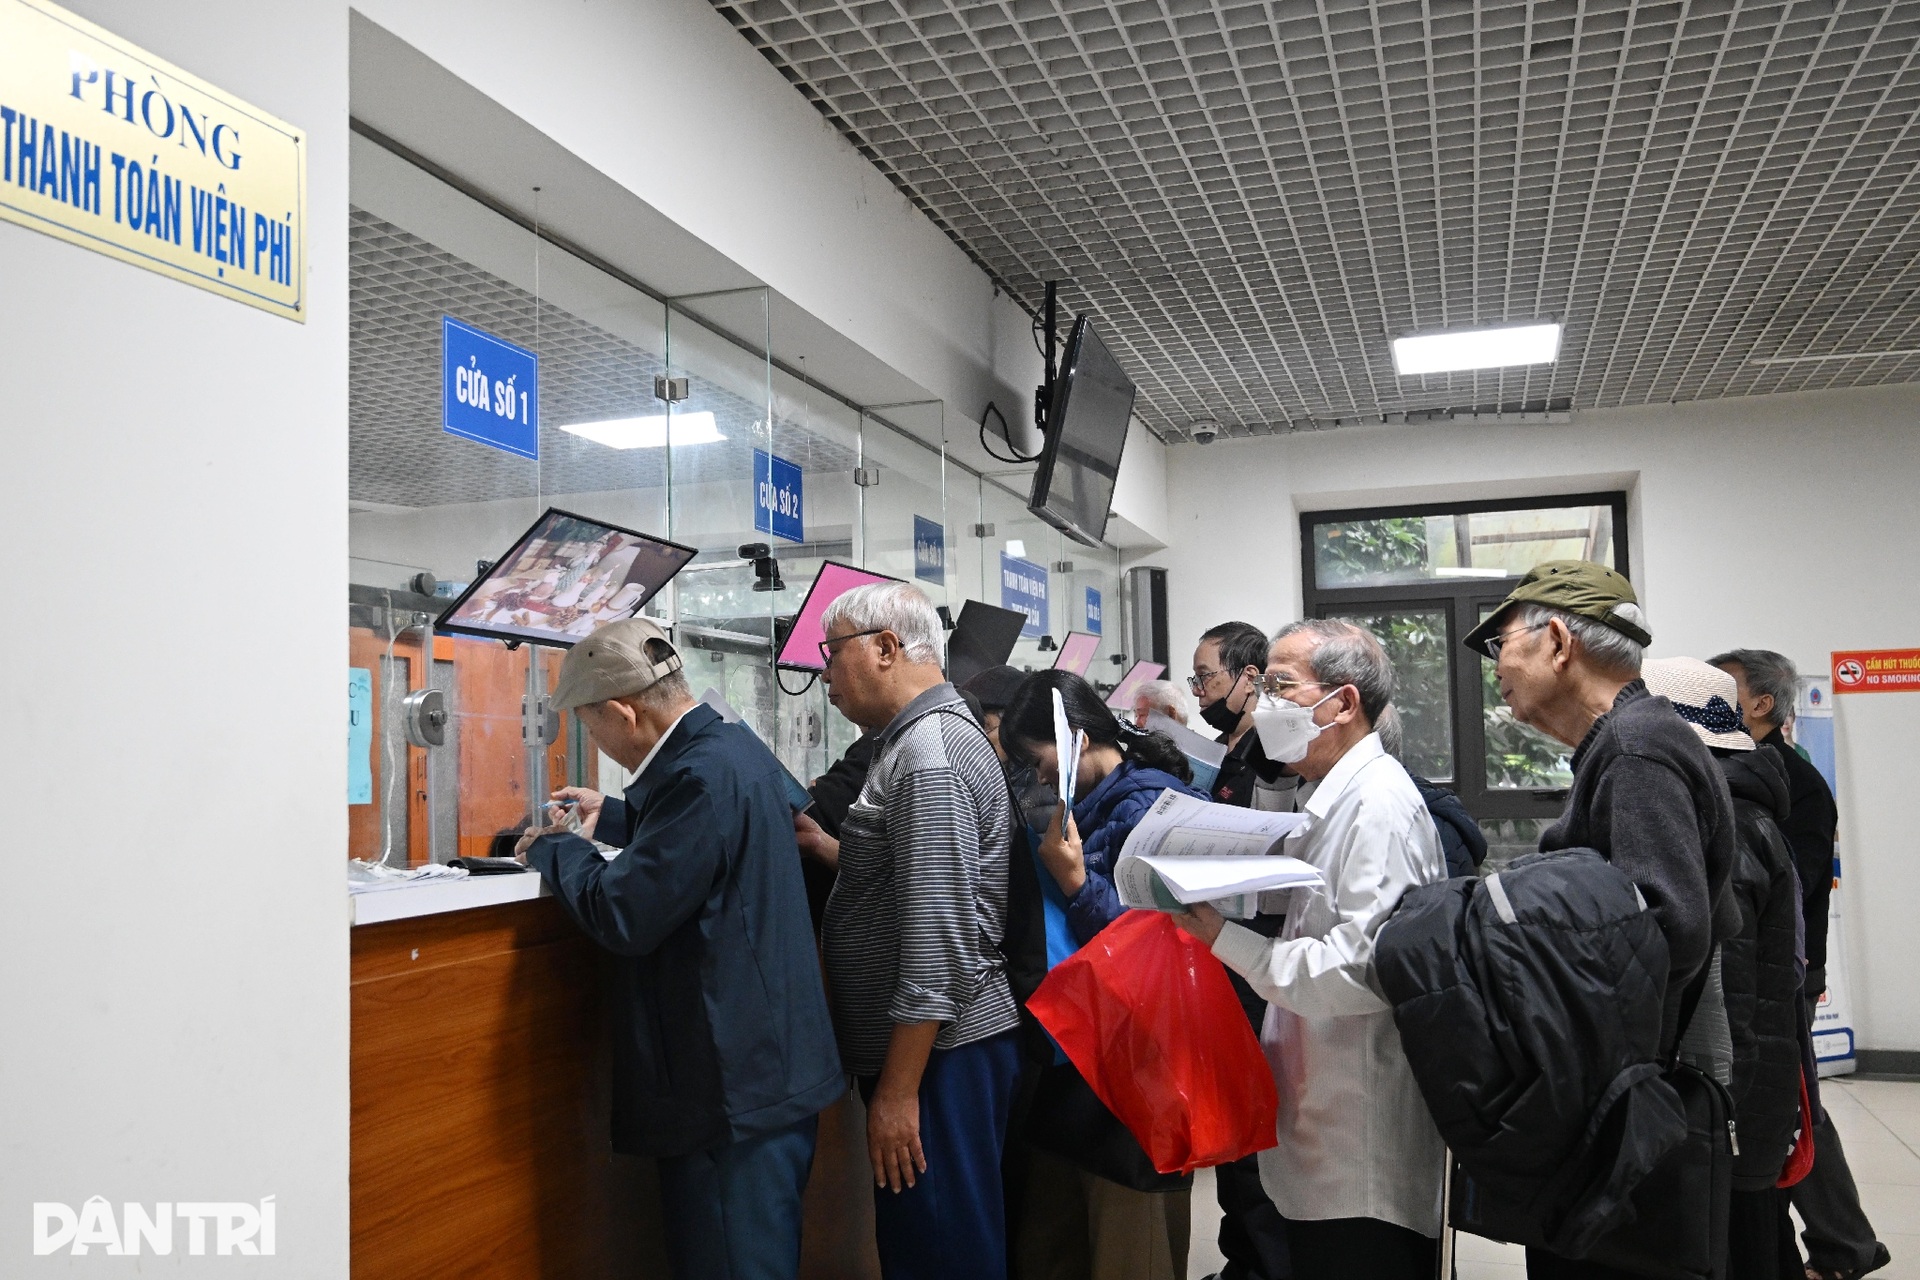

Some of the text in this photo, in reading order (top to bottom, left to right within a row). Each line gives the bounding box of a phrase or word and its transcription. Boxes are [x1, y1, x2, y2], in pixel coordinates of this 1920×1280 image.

[69, 54, 243, 170] PHÒNG
[1, 104, 291, 287] THANH TOÁN VIỆN PHÍ
[456, 355, 528, 426] CỬA SỐ 1
[759, 472, 799, 519] CỬA SỐ 2
[1865, 656, 1882, 670] CẤM
[1883, 656, 1897, 670] HÚT
[1866, 675, 1880, 684] NO
